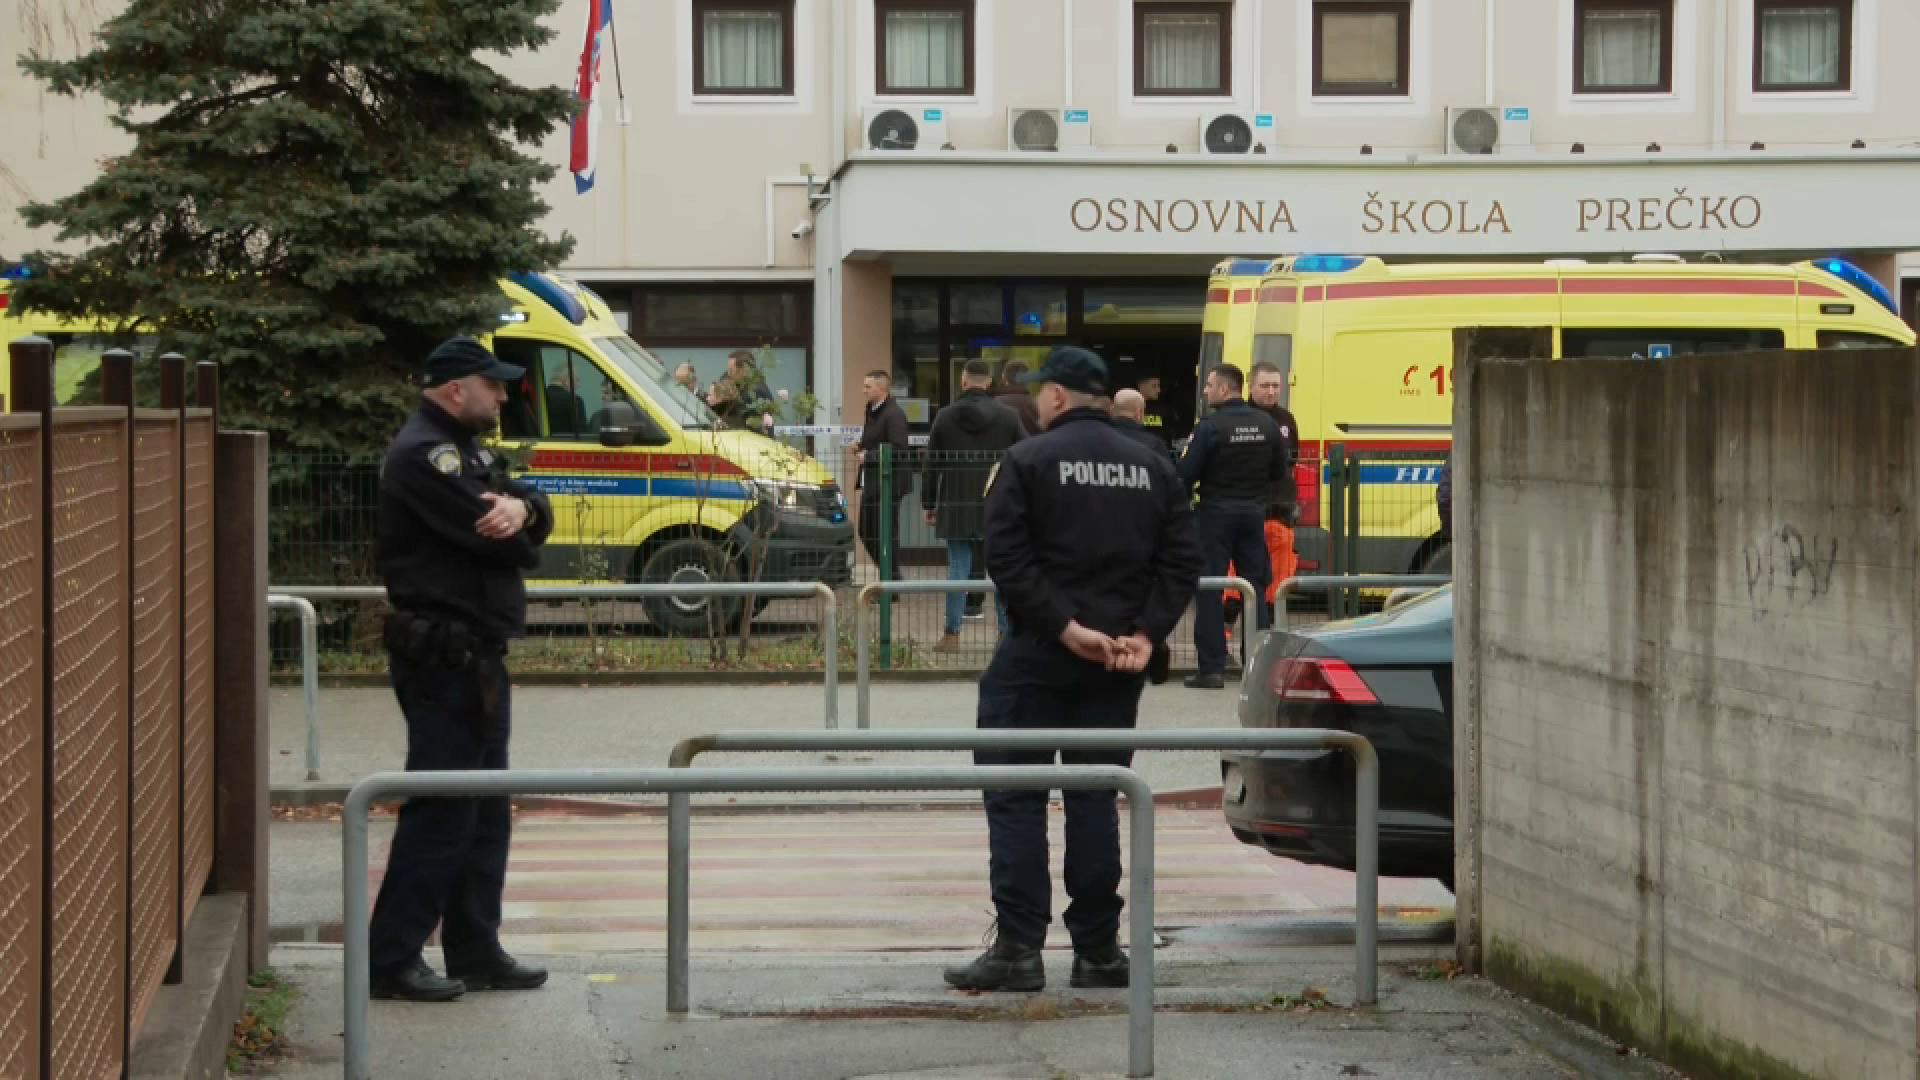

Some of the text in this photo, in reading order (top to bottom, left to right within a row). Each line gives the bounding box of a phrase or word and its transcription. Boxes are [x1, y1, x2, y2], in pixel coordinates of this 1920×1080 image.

[1070, 186, 1762, 233] OSNOVNA ŠKOLA PREČKO
[1058, 461, 1153, 491] POLICIJA
